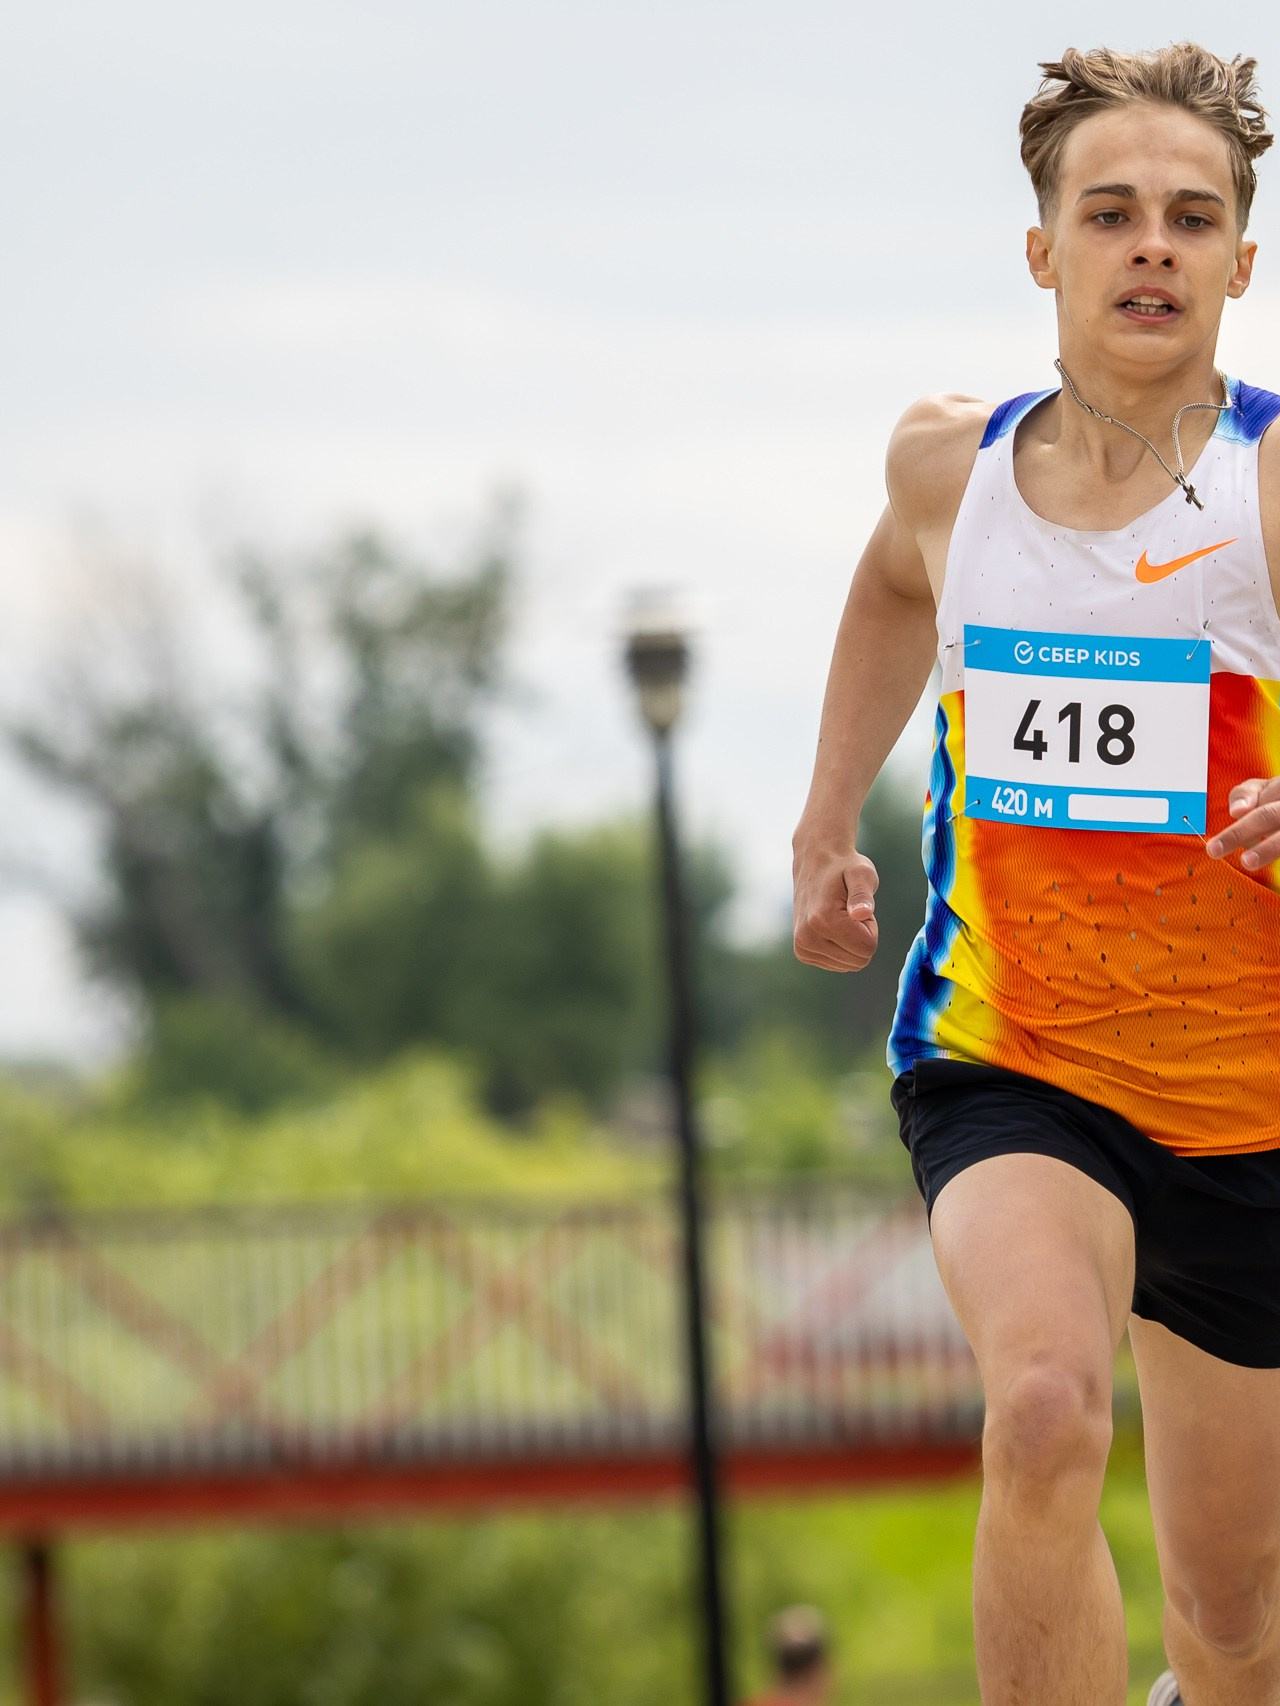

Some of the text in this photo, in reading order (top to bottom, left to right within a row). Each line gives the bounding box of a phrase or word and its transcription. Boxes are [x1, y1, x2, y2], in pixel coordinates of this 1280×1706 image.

[1038, 646, 1141, 666] СБЕР KIDS
[1013, 699, 1135, 766] 418
[991, 786, 1028, 816] 420
